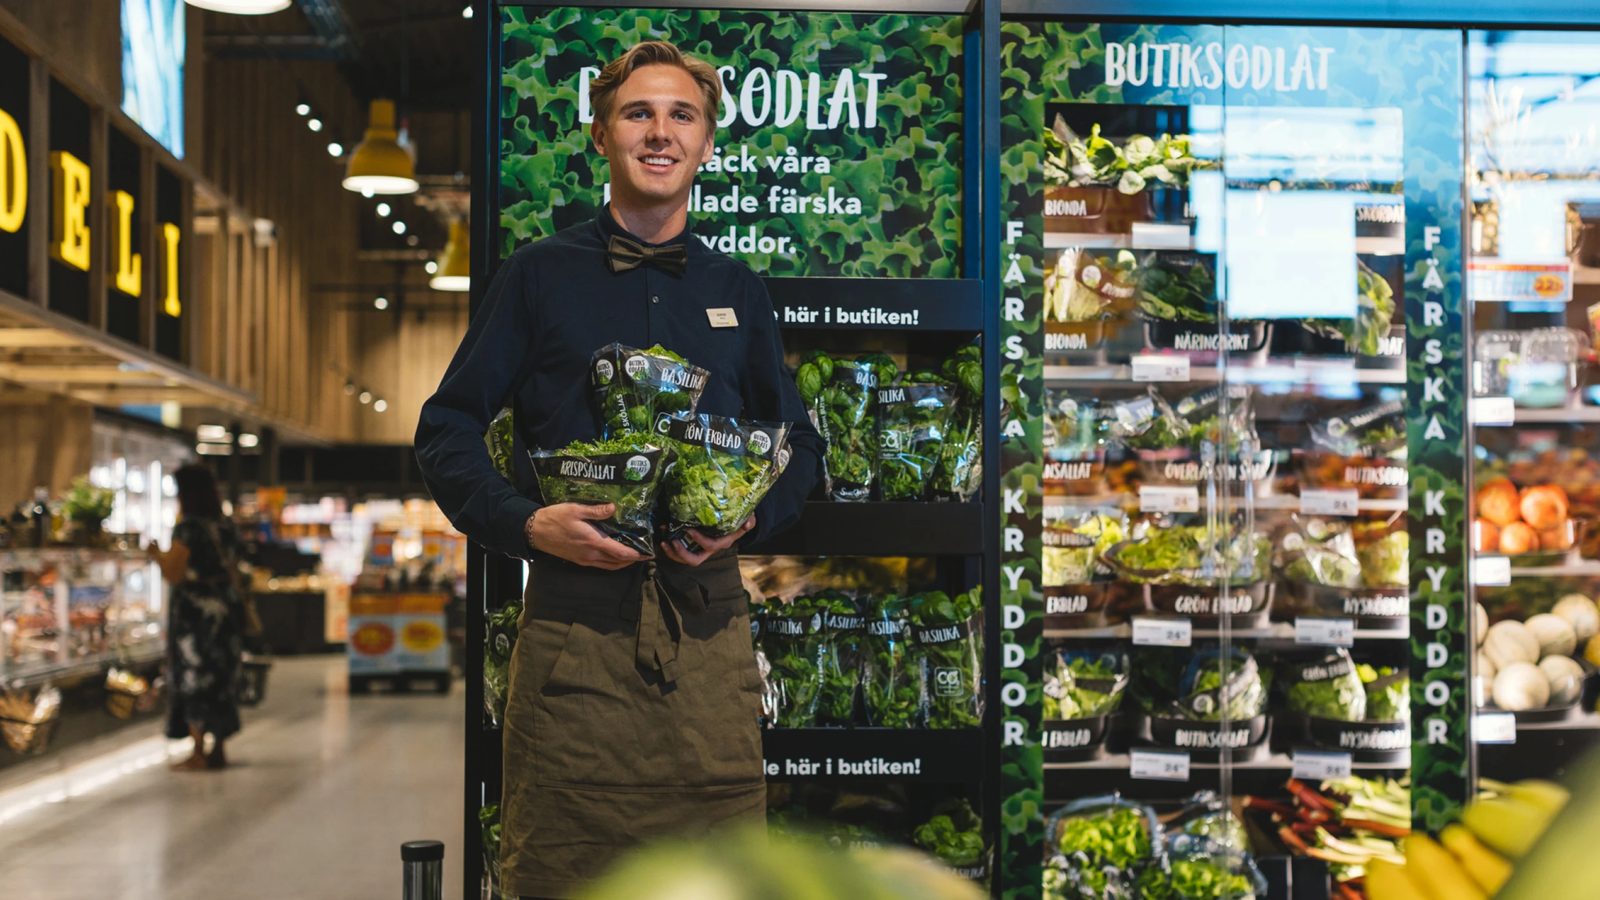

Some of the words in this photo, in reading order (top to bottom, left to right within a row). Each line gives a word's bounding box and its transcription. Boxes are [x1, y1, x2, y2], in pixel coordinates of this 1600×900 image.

[1105, 42, 1335, 91] BUTIKSODLAT
[766, 146, 831, 174] våra
[767, 185, 862, 215] färska
[784, 306, 819, 323] här
[824, 306, 831, 323] i
[836, 307, 919, 325] butiken!
[1422, 226, 1446, 440] FÄRSKA
[704, 428, 741, 449] EKBLAD
[560, 460, 616, 480] KRISPSALLAT
[1001, 488, 1028, 746] KRYDDOR
[1424, 489, 1450, 745] KRYDDOR
[786, 758, 820, 775] här
[826, 758, 832, 774] i
[838, 758, 920, 775] butiken!
